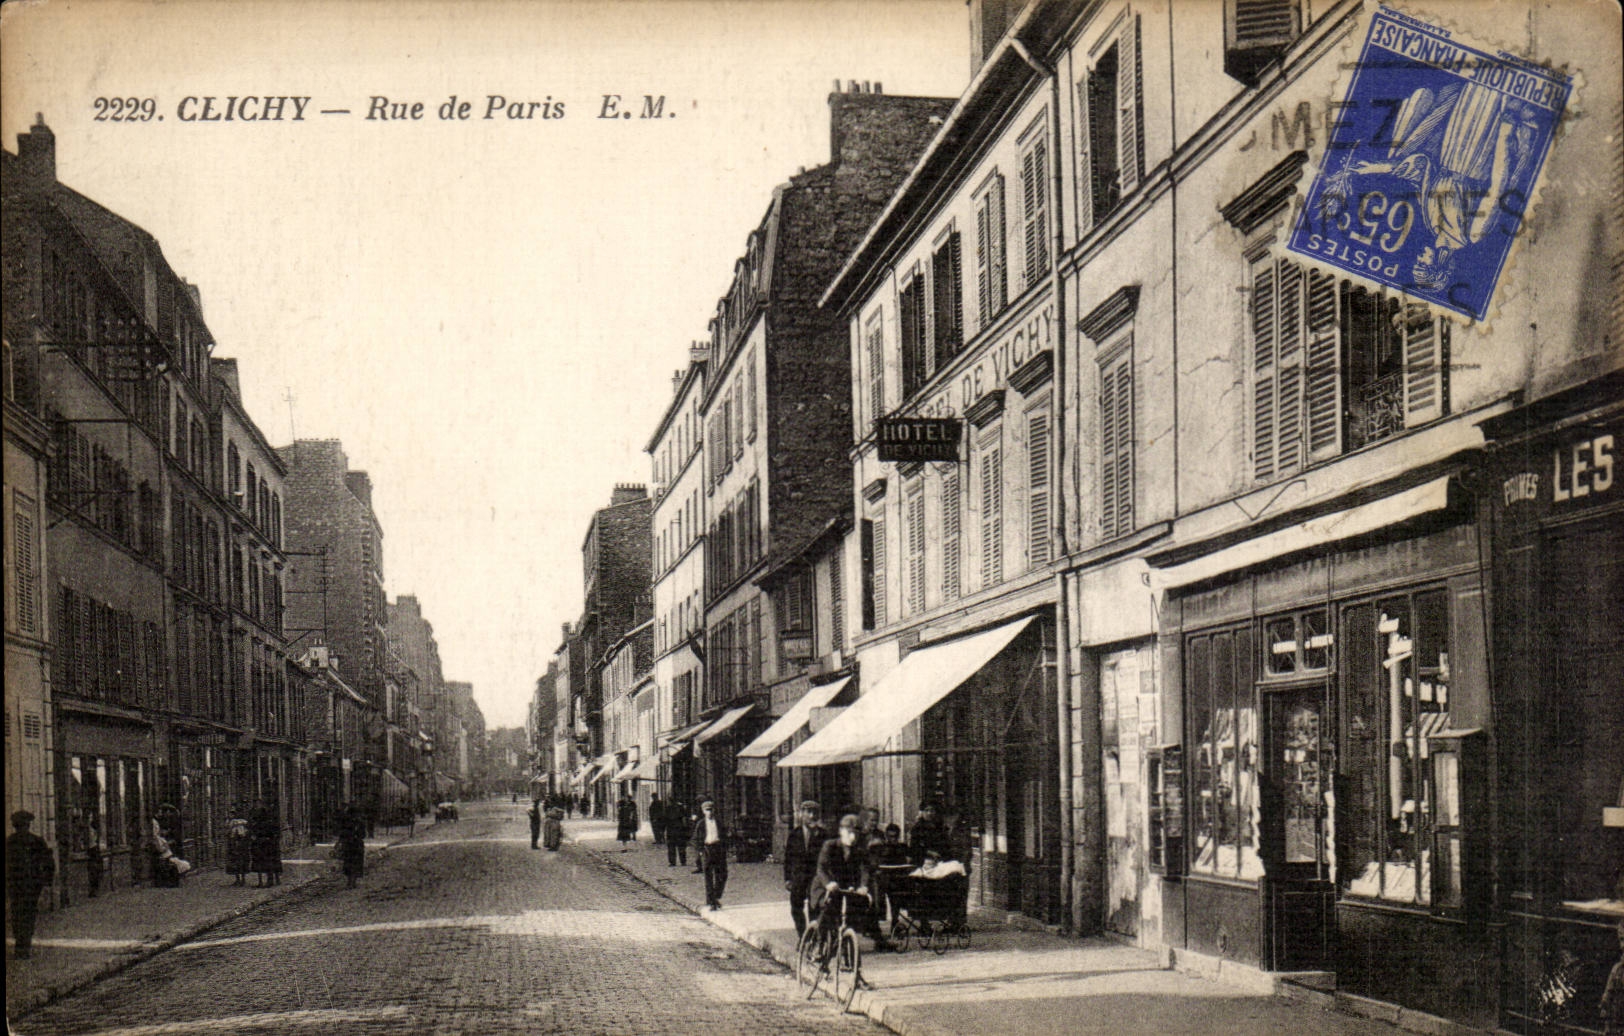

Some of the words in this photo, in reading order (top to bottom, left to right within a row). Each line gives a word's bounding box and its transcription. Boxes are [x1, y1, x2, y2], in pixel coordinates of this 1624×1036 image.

[1307, 234, 1399, 278] POSTES
[961, 363, 984, 409] DE
[991, 304, 1054, 390] VICHY
[883, 423, 952, 441] HOTEL
[1554, 434, 1615, 502] LES
